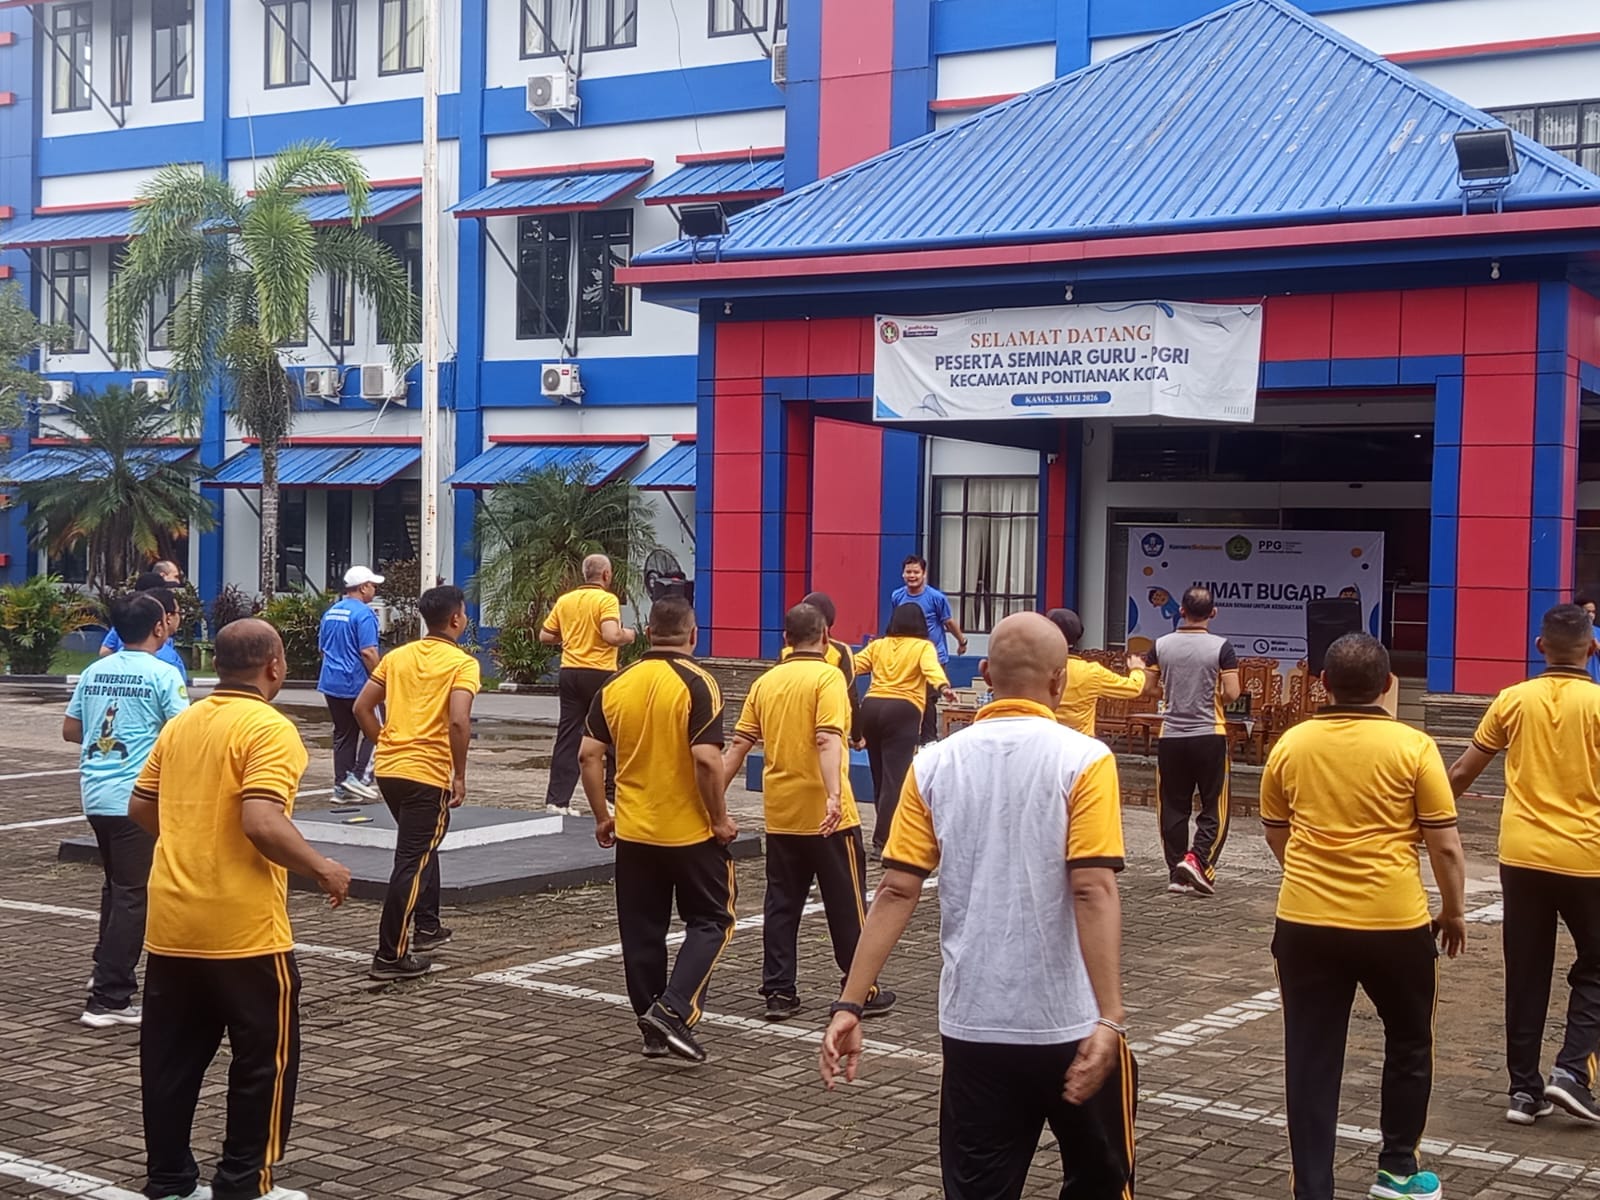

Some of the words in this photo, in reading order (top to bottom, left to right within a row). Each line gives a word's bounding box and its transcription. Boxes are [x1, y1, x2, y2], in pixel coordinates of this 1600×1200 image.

[970, 328, 1062, 348] SELAMAT
[1067, 325, 1151, 344] DATANG
[935, 353, 1004, 371] PESERTA
[1008, 350, 1082, 368] SEMINAR
[1086, 347, 1136, 365] GURU
[1151, 346, 1189, 364] PGRI
[950, 371, 1038, 387] KECAMATAN
[1042, 368, 1130, 384] PONTIANAK
[1133, 366, 1169, 381] KOTA
[1025, 395, 1053, 404] KAMIS,
[1055, 395, 1063, 403] 21
[1065, 394, 1081, 403] MEI
[1258, 540, 1282, 550] PPG
[1193, 581, 1253, 600] MAT
[1256, 583, 1327, 602] BUGAR
[94, 673, 144, 685] UNIVERSITAS
[101, 686, 152, 699] PONTIANAK
